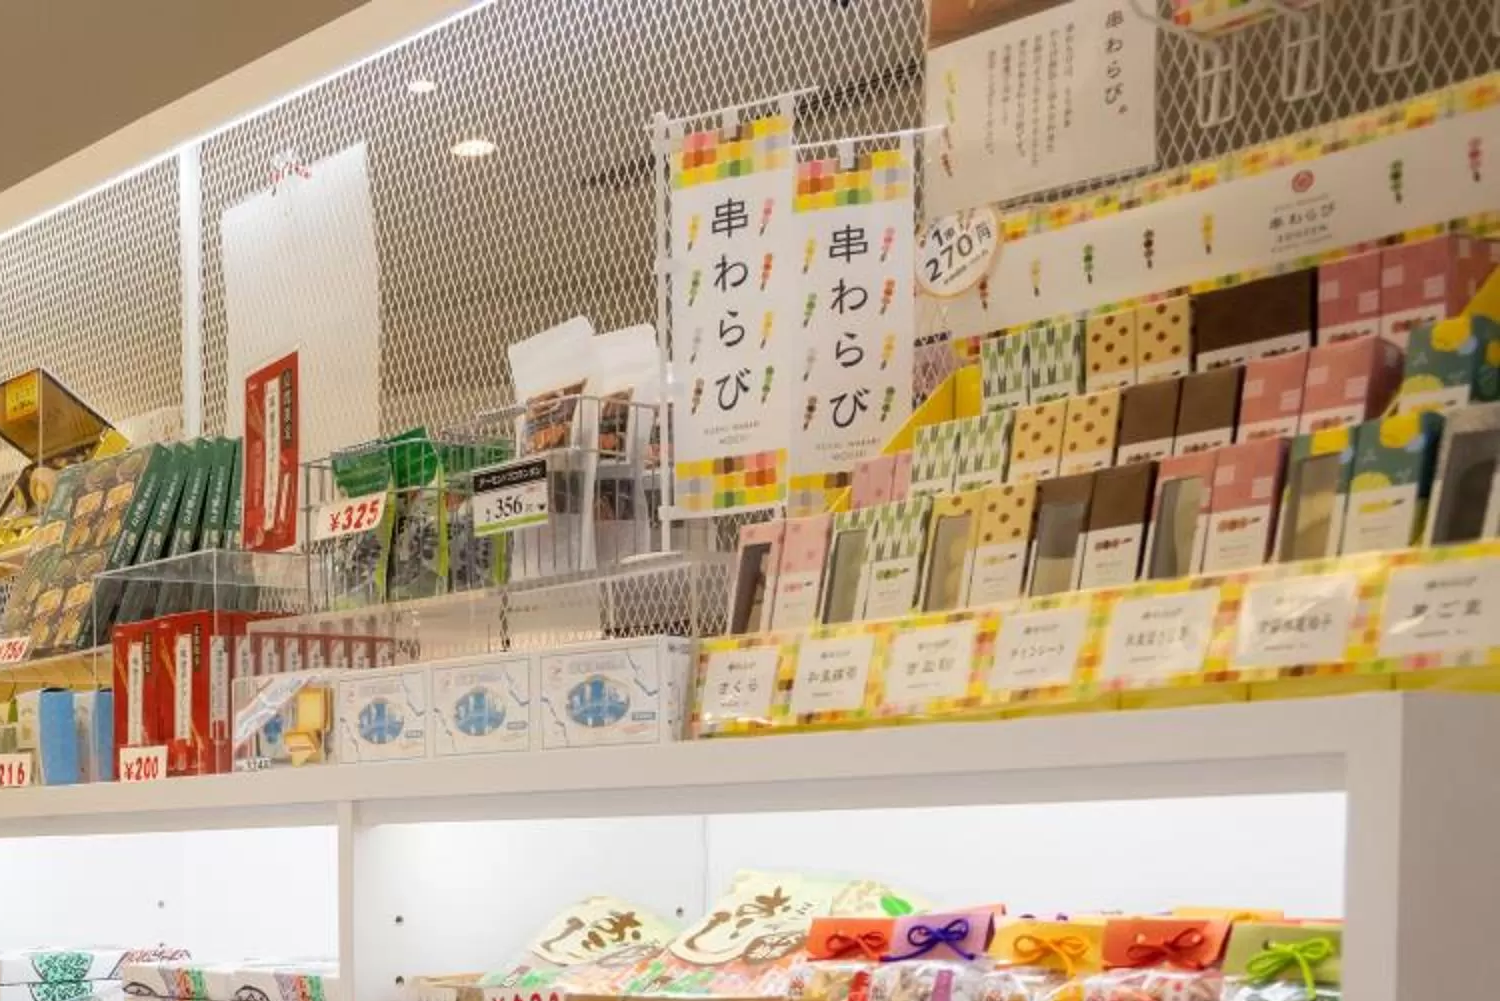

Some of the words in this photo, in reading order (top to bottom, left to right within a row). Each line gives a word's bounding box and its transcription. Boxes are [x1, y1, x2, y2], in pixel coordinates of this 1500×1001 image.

[711, 198, 751, 411] 串わらび
[828, 223, 870, 429] 串わらび
[328, 500, 381, 532] ¥325
[124, 756, 160, 780] ¥200
